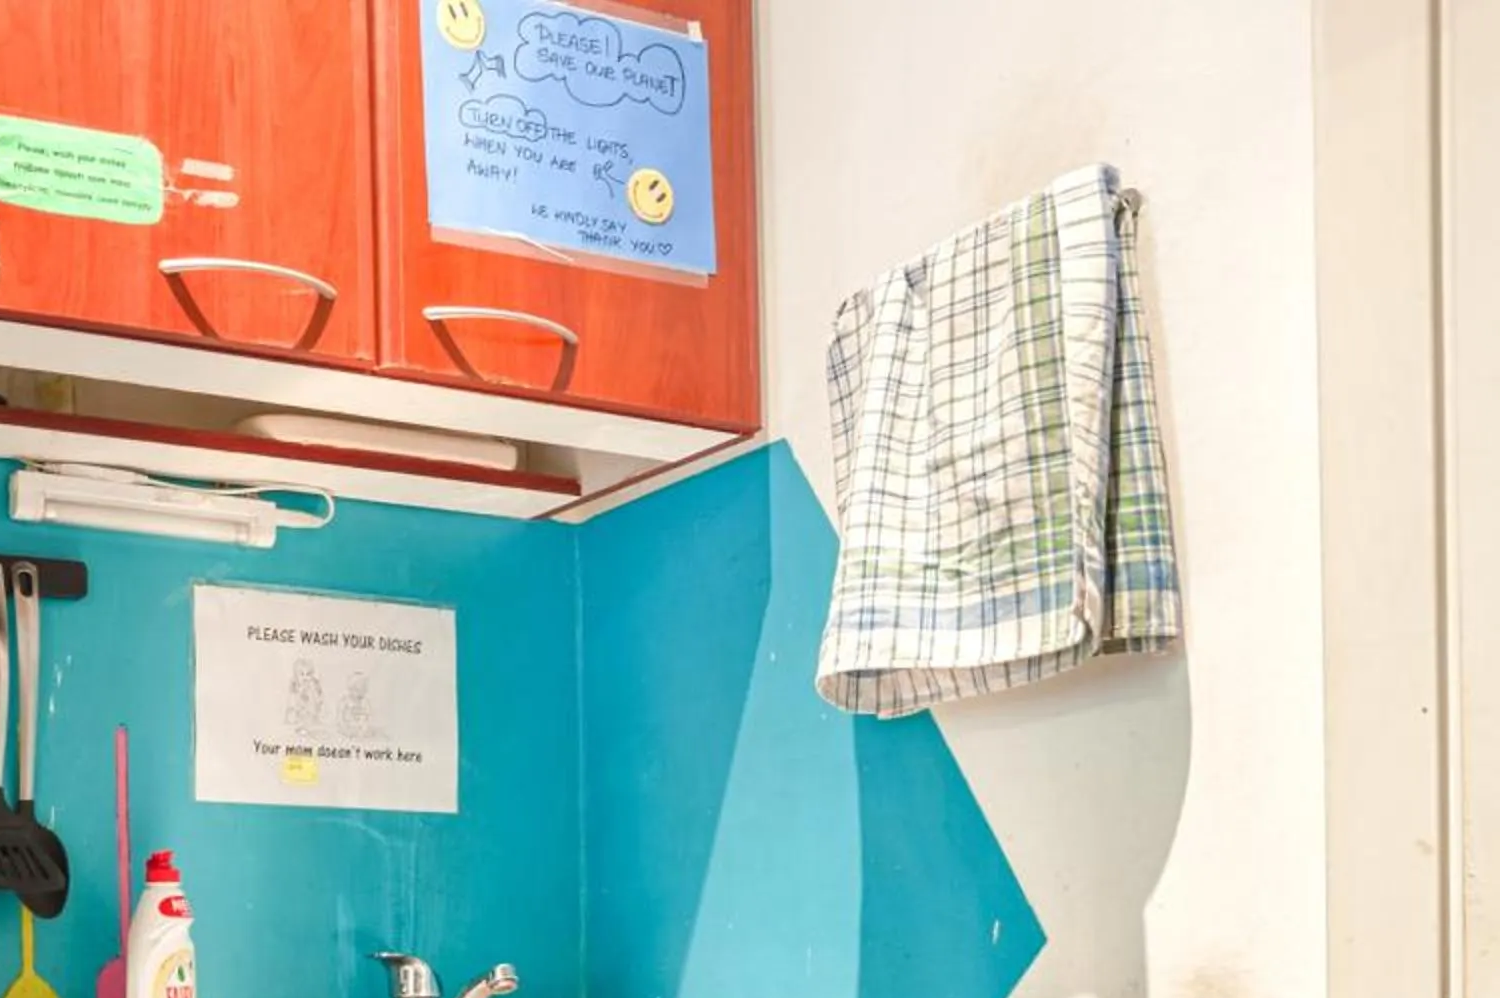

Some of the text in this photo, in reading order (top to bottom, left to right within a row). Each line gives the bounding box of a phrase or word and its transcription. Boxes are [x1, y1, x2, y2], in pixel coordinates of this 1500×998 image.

[534, 23, 610, 57] PLEASE!
[537, 47, 678, 97] SAVE OUR PLANET
[466, 107, 512, 129] TURN
[515, 119, 544, 135] OFF
[549, 127, 577, 145] THE
[463, 132, 577, 173] WHEN YOU ARE
[630, 239, 655, 255] YOU
[247, 626, 422, 654] PLEASE WASH YOUR DISHES
[253, 739, 423, 764] Your mom doesn't work here
